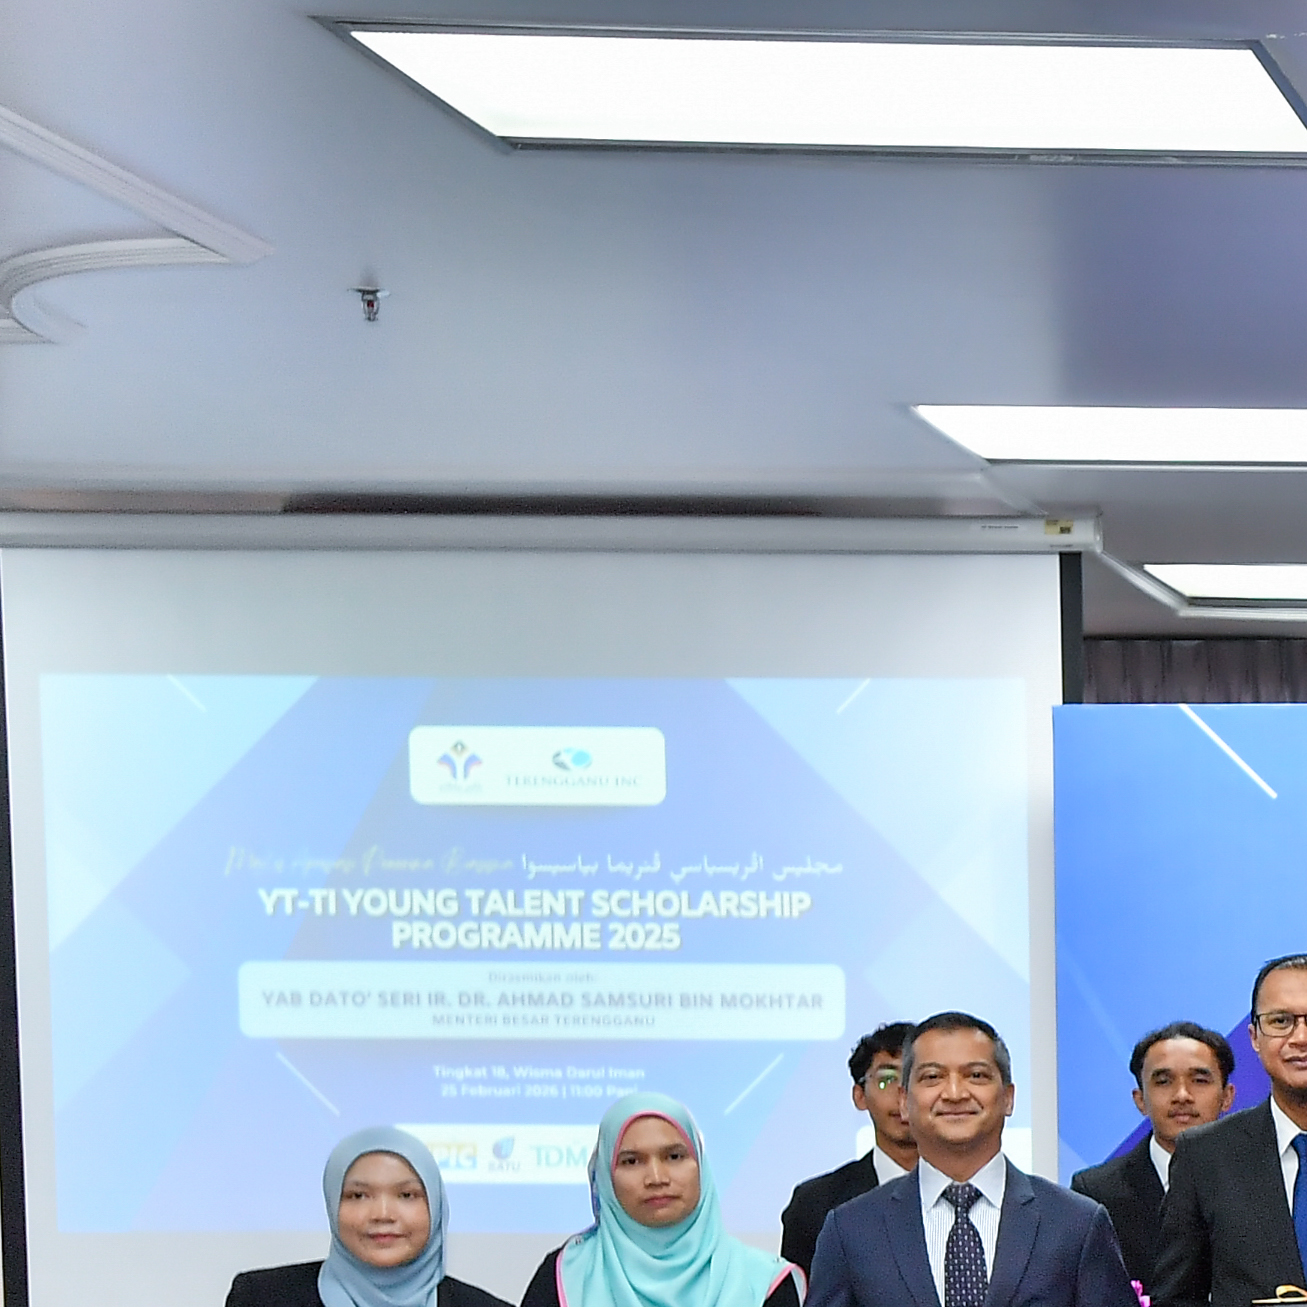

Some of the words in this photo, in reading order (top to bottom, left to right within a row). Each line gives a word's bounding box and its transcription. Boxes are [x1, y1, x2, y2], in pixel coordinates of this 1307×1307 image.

[258, 888, 336, 916] YT-TI
[343, 888, 459, 917] YOUNG
[465, 889, 585, 917] TALENT
[592, 889, 812, 918] SCHOLARSHIP
[392, 921, 601, 949] PROGRAMME
[609, 922, 681, 950] 2025
[262, 990, 302, 1008] YAB
[309, 990, 371, 1008] DATO'
[378, 990, 421, 1008] SERI
[428, 990, 452, 1008] IR.
[458, 990, 491, 1008] DR.
[498, 990, 573, 1008] AHMAD
[581, 991, 672, 1009] SAMSURI
[680, 992, 713, 1009] BIN
[720, 992, 823, 1010] MOKHTAR
[432, 1014, 498, 1025] MENTERI
[503, 1014, 549, 1025] BESAR
[555, 1015, 655, 1027] TERENGGANU
[433, 1065, 487, 1081] Tingkat
[513, 1065, 562, 1080] Wisma
[566, 1066, 605, 1080] Darul
[609, 1066, 645, 1080] Iman
[461, 1083, 521, 1098] Februari
[530, 1144, 588, 1168] TDM
